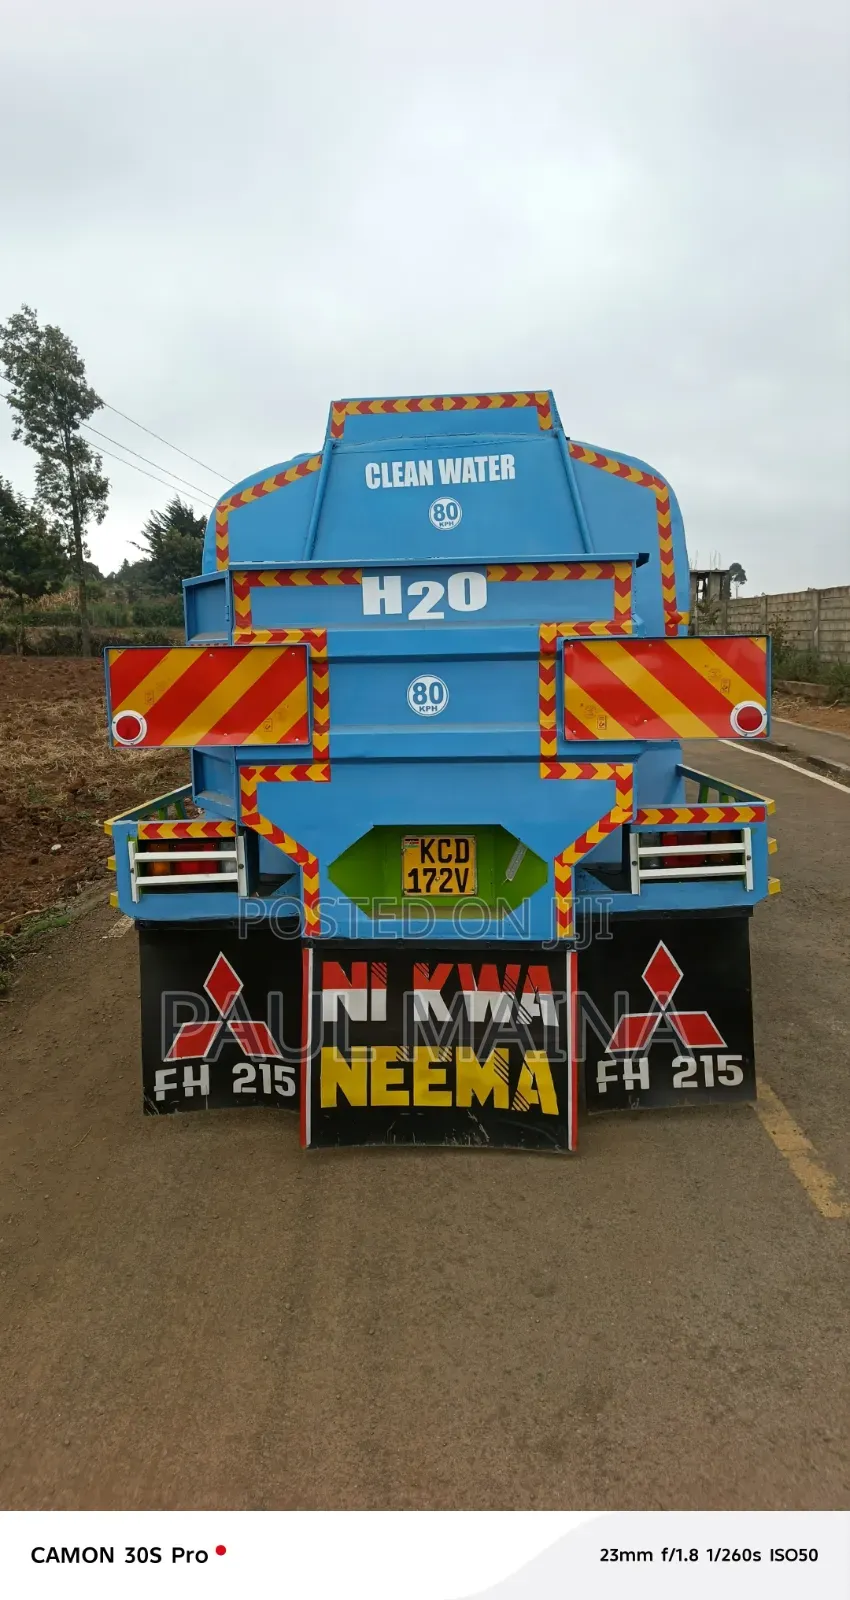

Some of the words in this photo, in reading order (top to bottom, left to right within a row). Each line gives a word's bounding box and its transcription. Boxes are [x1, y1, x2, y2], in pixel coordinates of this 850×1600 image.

[365, 459, 434, 489] CLEAN
[438, 453, 516, 485] WATER
[433, 502, 459, 521] 80
[362, 572, 488, 620] H2O
[412, 682, 444, 705] 80
[419, 705, 438, 713] KPH
[420, 839, 469, 863] KCD
[407, 868, 469, 893] 172V
[322, 961, 387, 1022] NI
[413, 963, 559, 1027] KWA
[154, 1064, 210, 1101] FH
[232, 1062, 296, 1097] 215
[320, 1046, 559, 1116] NEEMA
[596, 1057, 650, 1094] FH
[671, 1055, 744, 1089] 215
